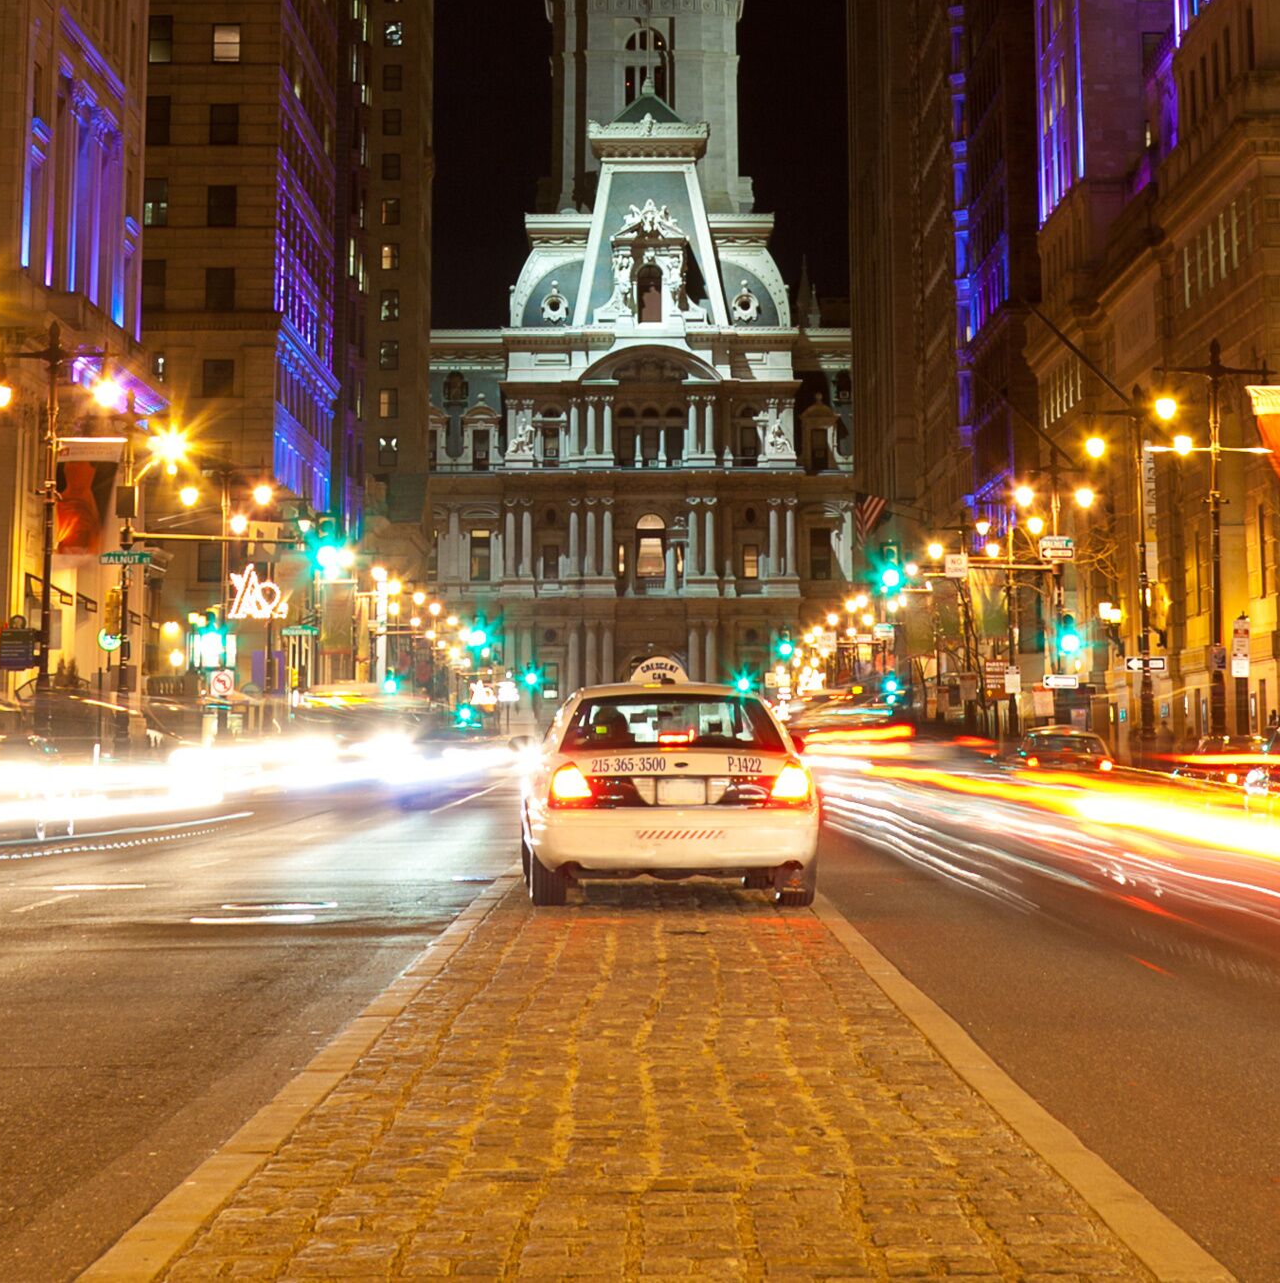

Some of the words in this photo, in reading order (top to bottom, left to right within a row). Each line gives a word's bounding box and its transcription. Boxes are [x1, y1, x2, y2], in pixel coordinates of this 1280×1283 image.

[101, 555, 140, 564] WALNUT
[951, 558, 962, 566] NO
[641, 662, 679, 673] CRESCENT
[592, 756, 666, 773] 215-365-3500
[727, 755, 763, 773] P-1422
